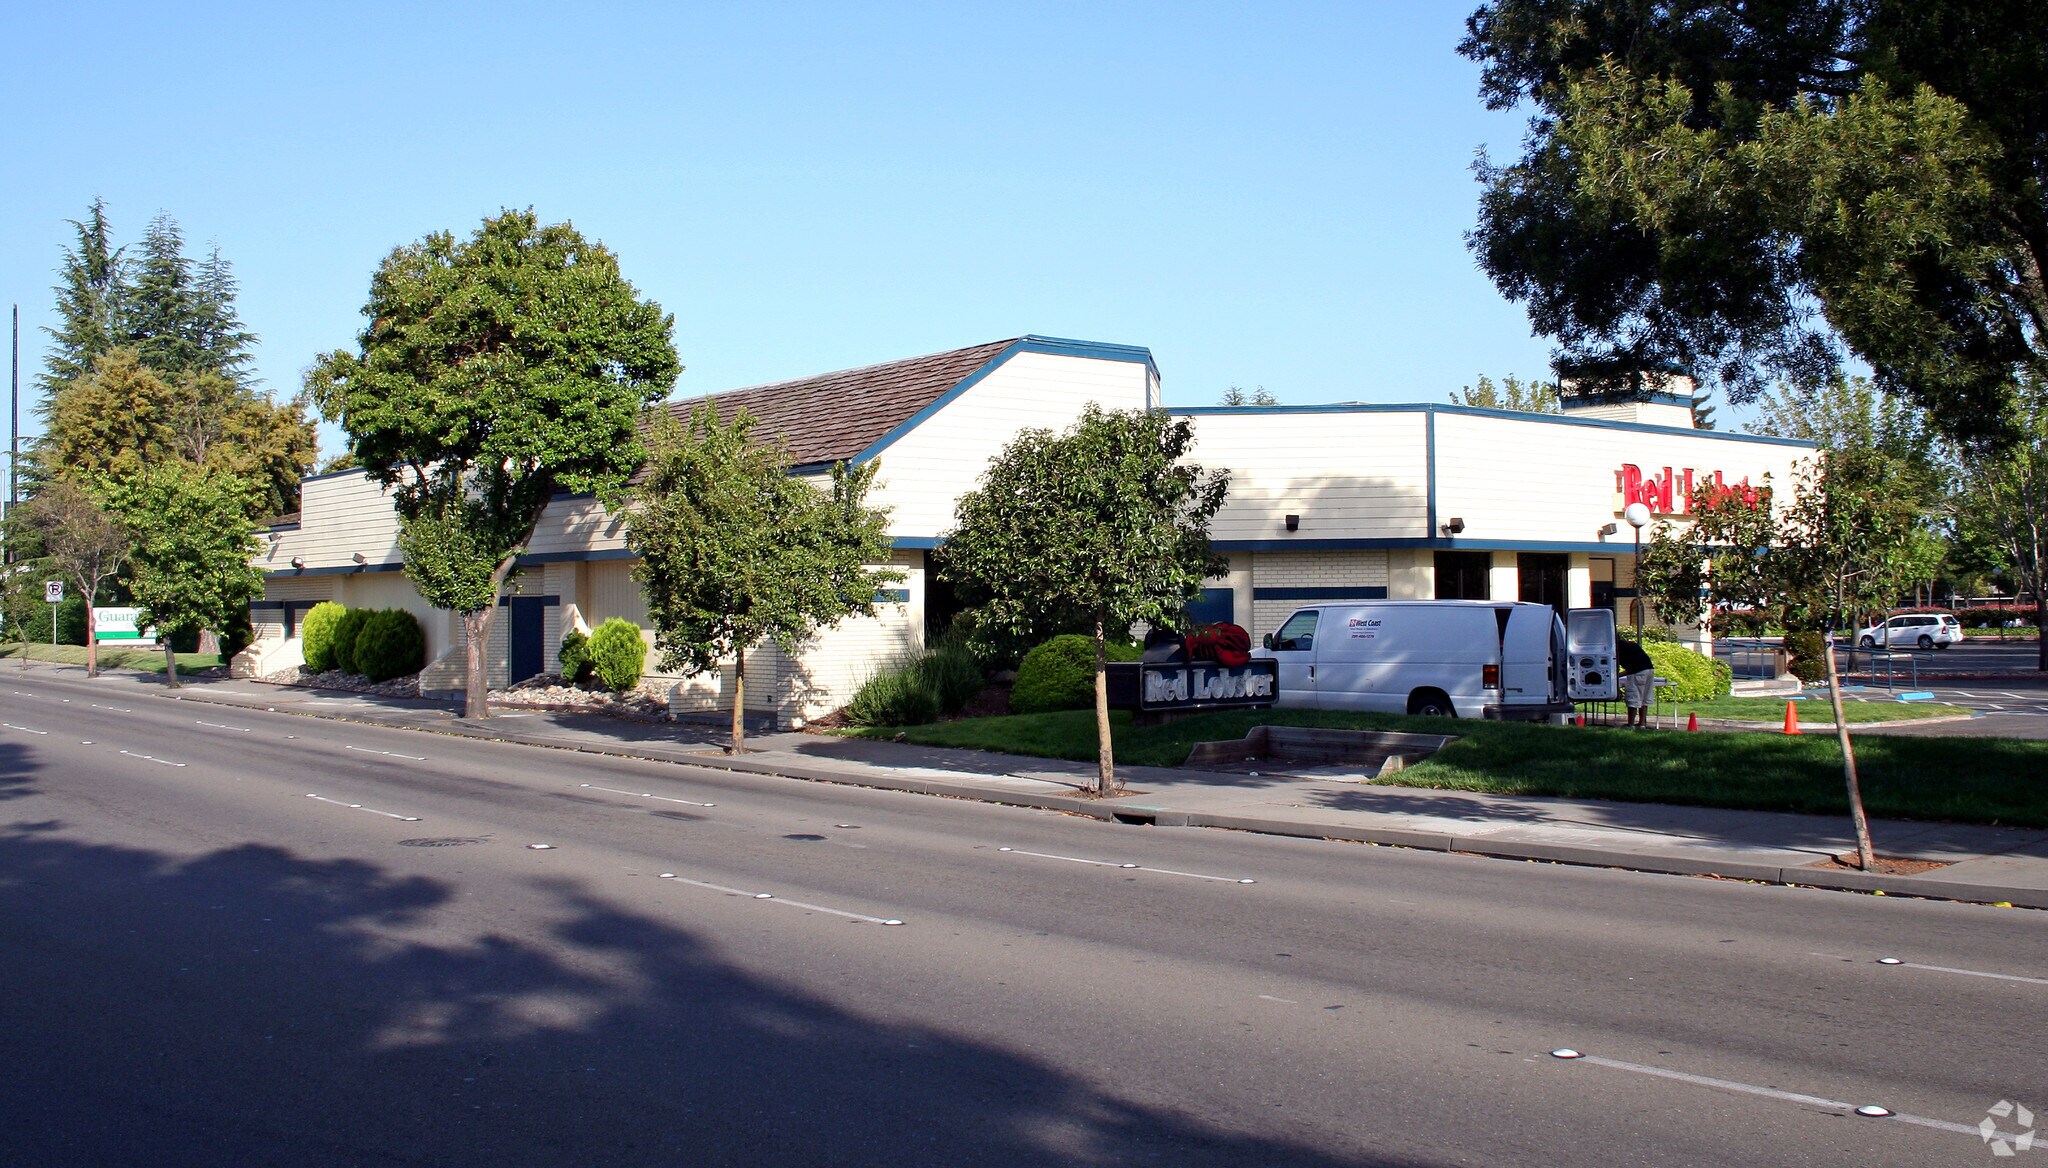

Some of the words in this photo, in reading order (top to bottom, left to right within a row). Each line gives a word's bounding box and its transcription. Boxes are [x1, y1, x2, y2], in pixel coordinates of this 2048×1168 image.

[1621, 463, 1674, 513] Red
[99, 610, 138, 622] Guara
[1144, 669, 1189, 702] Red
[1192, 668, 1273, 699] Lobster
